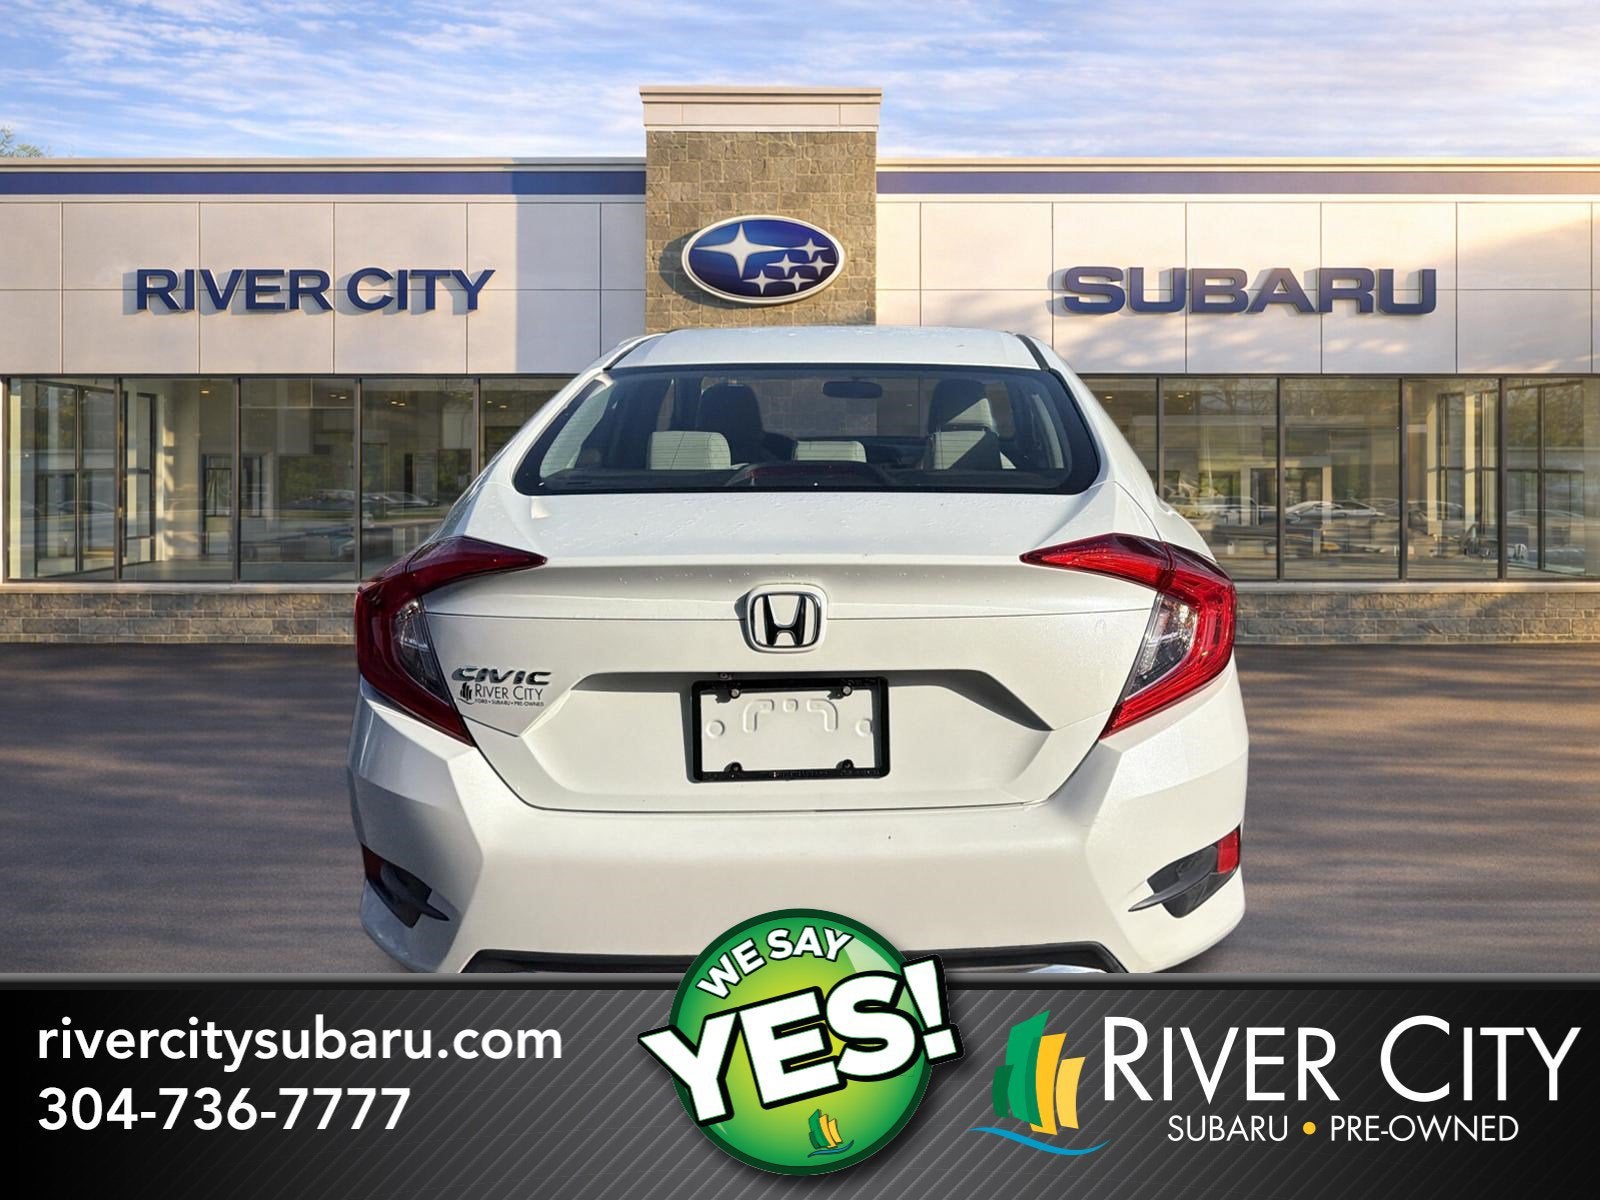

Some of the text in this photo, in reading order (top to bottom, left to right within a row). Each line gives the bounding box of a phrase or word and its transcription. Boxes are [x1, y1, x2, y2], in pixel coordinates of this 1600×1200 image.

[136, 267, 496, 311] RIVER CITY
[1062, 266, 1437, 315] SUBARU
[451, 667, 552, 686] CIVIC
[474, 683, 543, 701] RIVER CITY
